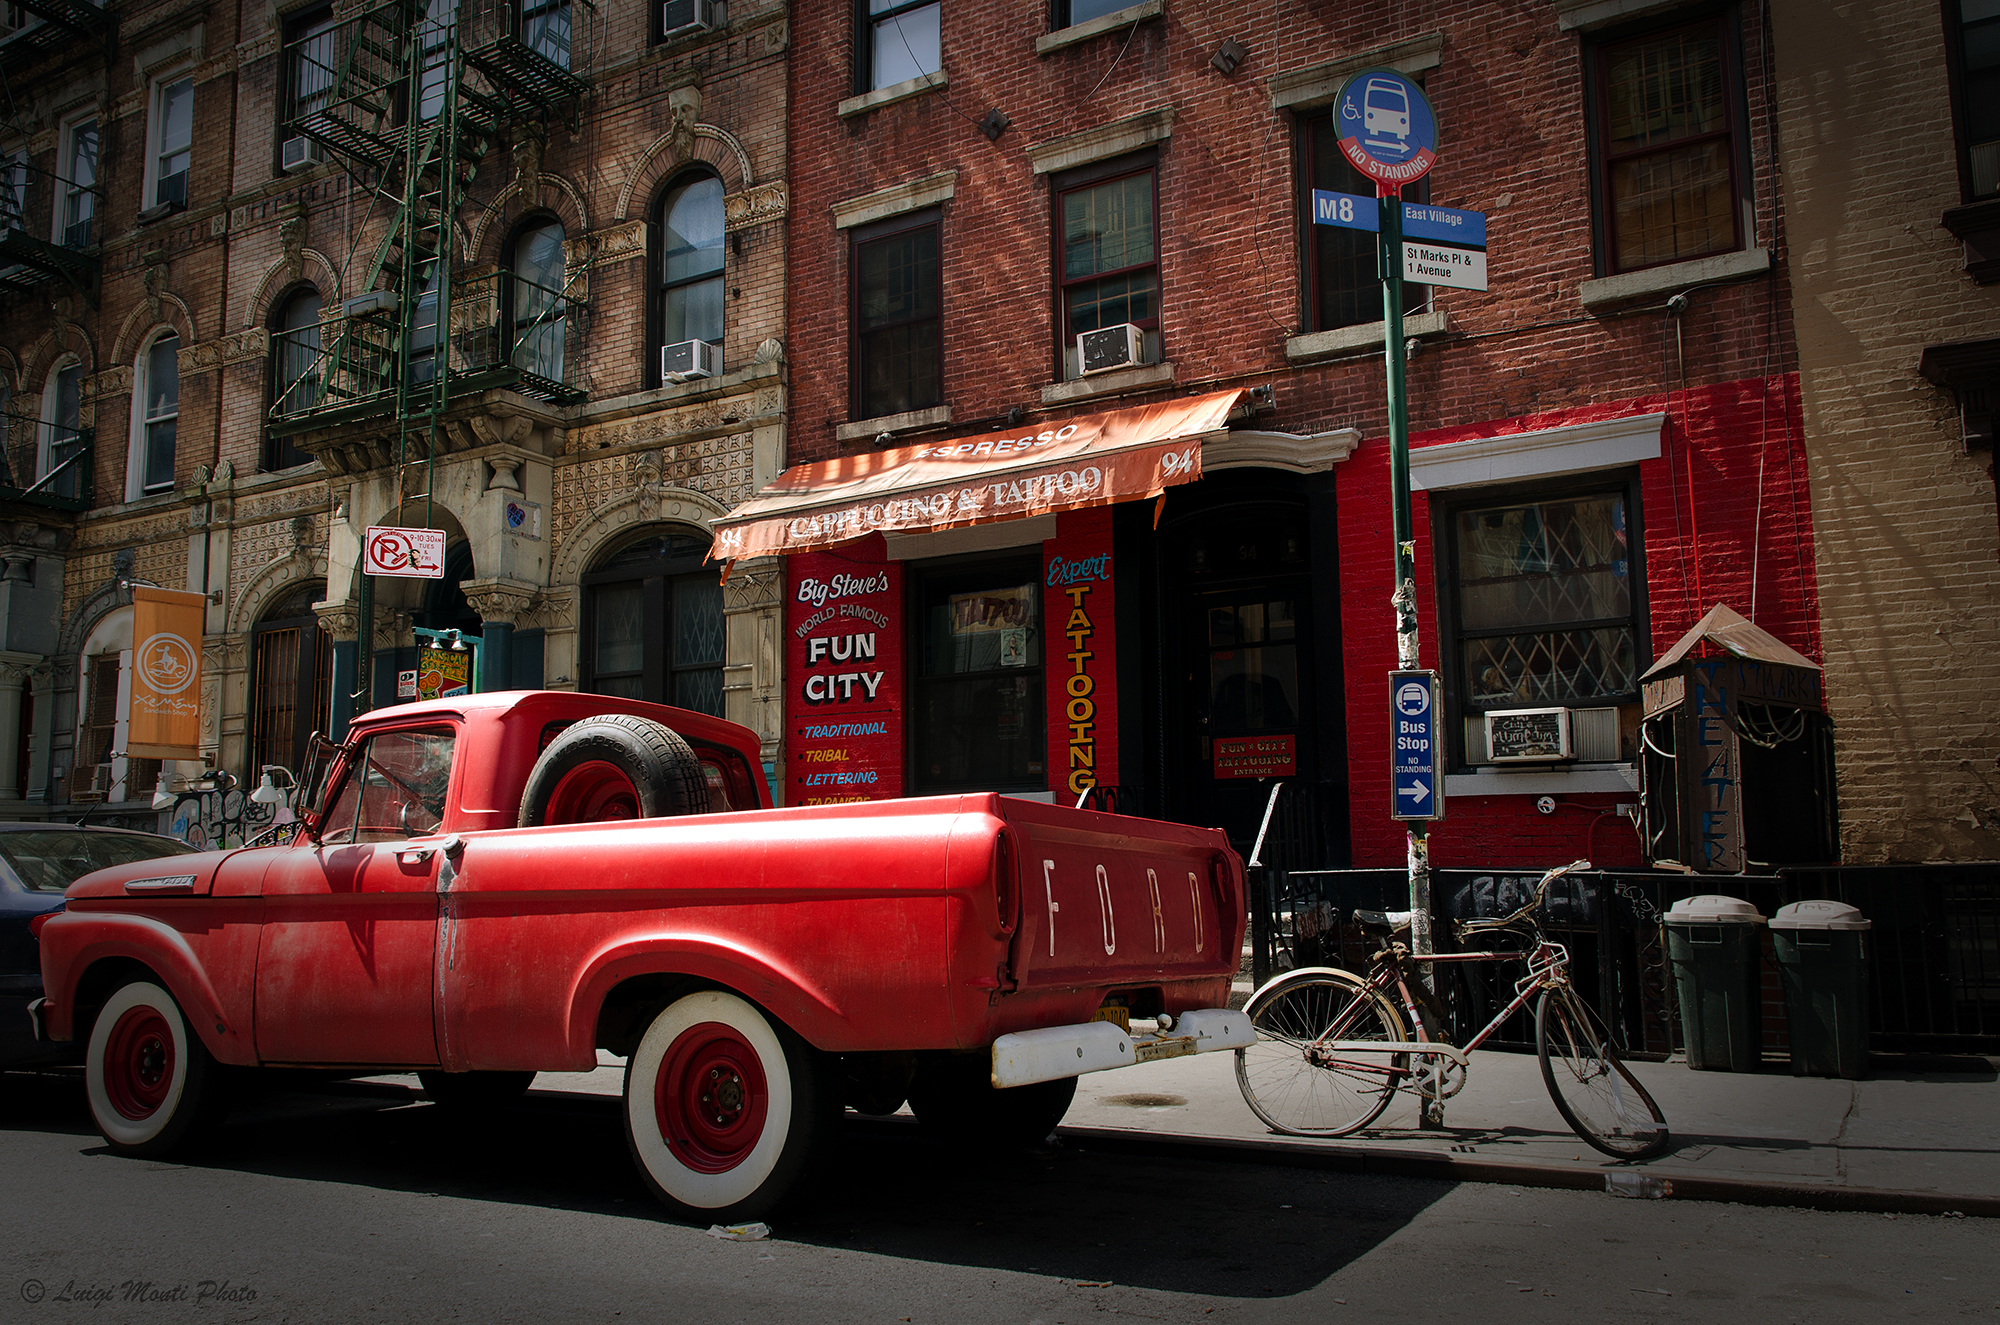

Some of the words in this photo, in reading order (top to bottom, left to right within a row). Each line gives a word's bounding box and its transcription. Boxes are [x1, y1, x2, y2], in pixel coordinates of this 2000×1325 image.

[1348, 144, 1367, 166] NO
[1368, 154, 1429, 180] STANDING
[1319, 197, 1354, 223] M8
[1405, 206, 1427, 222] East
[1429, 209, 1463, 227] Village
[1407, 247, 1418, 259] St
[1420, 249, 1450, 264] Marks
[1452, 253, 1462, 265] Pl
[1464, 255, 1472, 266] &
[1407, 263, 1413, 274] 1
[1416, 264, 1452, 278] Avenue
[914, 424, 1079, 460] ESPRESSO
[720, 527, 743, 551] 94
[789, 491, 950, 539] CAPPUCCINO
[956, 488, 980, 511] &
[988, 466, 1102, 507] TATTOO
[1160, 448, 1193, 478] 94
[1239, 544, 1258, 560] 94
[1046, 553, 1111, 586] Expert
[797, 577, 829, 607] Big
[828, 570, 889, 599] Steve's
[795, 607, 836, 638] WORLD
[840, 604, 889, 629] FAMOUS
[954, 596, 1030, 630] TATTOO
[808, 632, 876, 664] FUN
[1212, 651, 1235, 661] PUSH
[805, 671, 885, 701] CITY
[1064, 585, 1097, 796] TATTOOING
[143, 706, 172, 716] Sandwich
[173, 708, 188, 717] Shop
[805, 721, 888, 739] TRADITIONAL
[1400, 720, 1426, 734] Bus
[1220, 742, 1247, 754] FUN
[1256, 739, 1289, 752] CITY
[1397, 736, 1429, 752] Stop
[805, 749, 850, 763] TRIBAL
[1217, 753, 1292, 768] TATTOOING
[1407, 757, 1419, 765] NO
[1694, 661, 1735, 868] THEATER
[805, 771, 878, 786] LETTERING
[1233, 767, 1273, 776] ENTRANCE
[1395, 765, 1432, 774] STANDING
[1043, 859, 1204, 957] FORD
